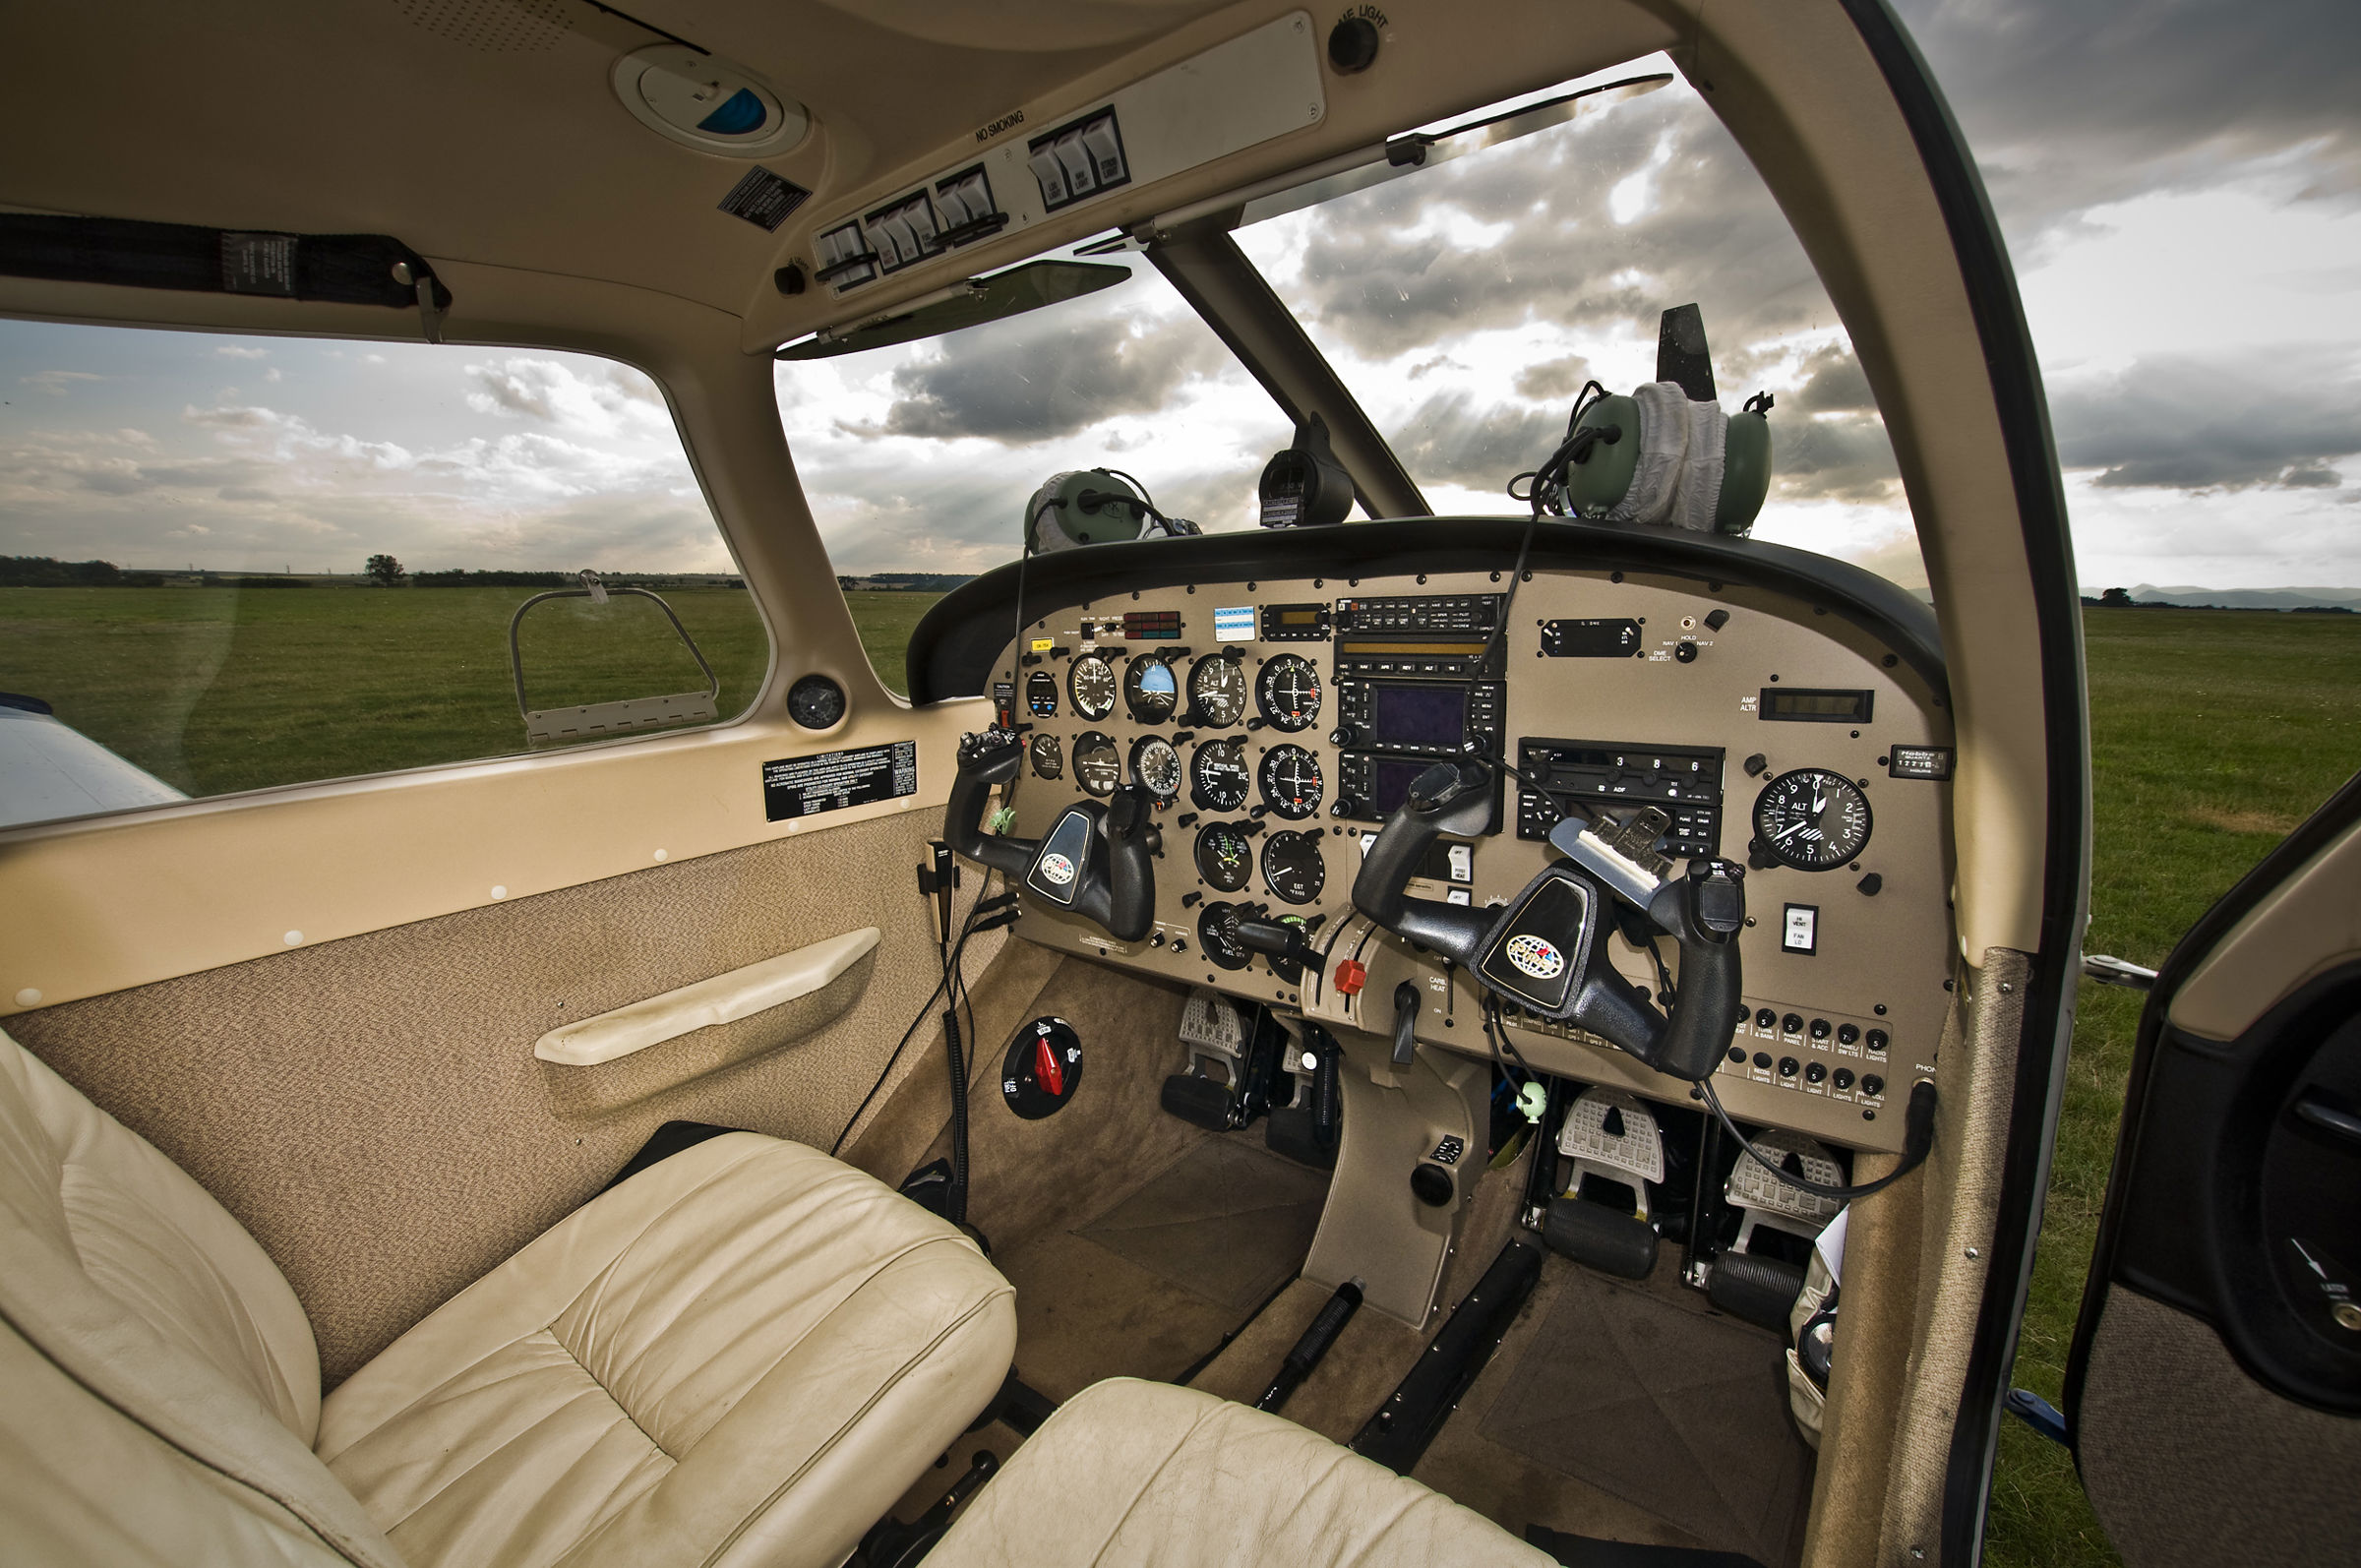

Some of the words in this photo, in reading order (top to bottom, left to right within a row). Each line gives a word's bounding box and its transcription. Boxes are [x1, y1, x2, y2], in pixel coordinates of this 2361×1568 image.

[1360, 4, 1389, 28] LIGHT
[976, 128, 988, 143] NO
[988, 110, 1024, 138] SMOKING
[1617, 757, 1623, 766] 3
[1654, 758, 1661, 768] 8
[1691, 761, 1698, 771] 6
[1790, 784, 1797, 794] 9
[1812, 780, 1820, 790] 0
[1779, 795, 1786, 804] 8
[1846, 803, 1853, 813] 2
[1777, 824, 1784, 833] 7
[1843, 828, 1850, 838] 3
[1786, 837, 1792, 846] 6
[1829, 841, 1838, 851] 4
[1806, 845, 1814, 854] 5
[1866, 1054, 1887, 1062] LIGHTS
[1915, 1063, 1936, 1072] PHON
[1753, 1075, 1770, 1084] LIGHTS
